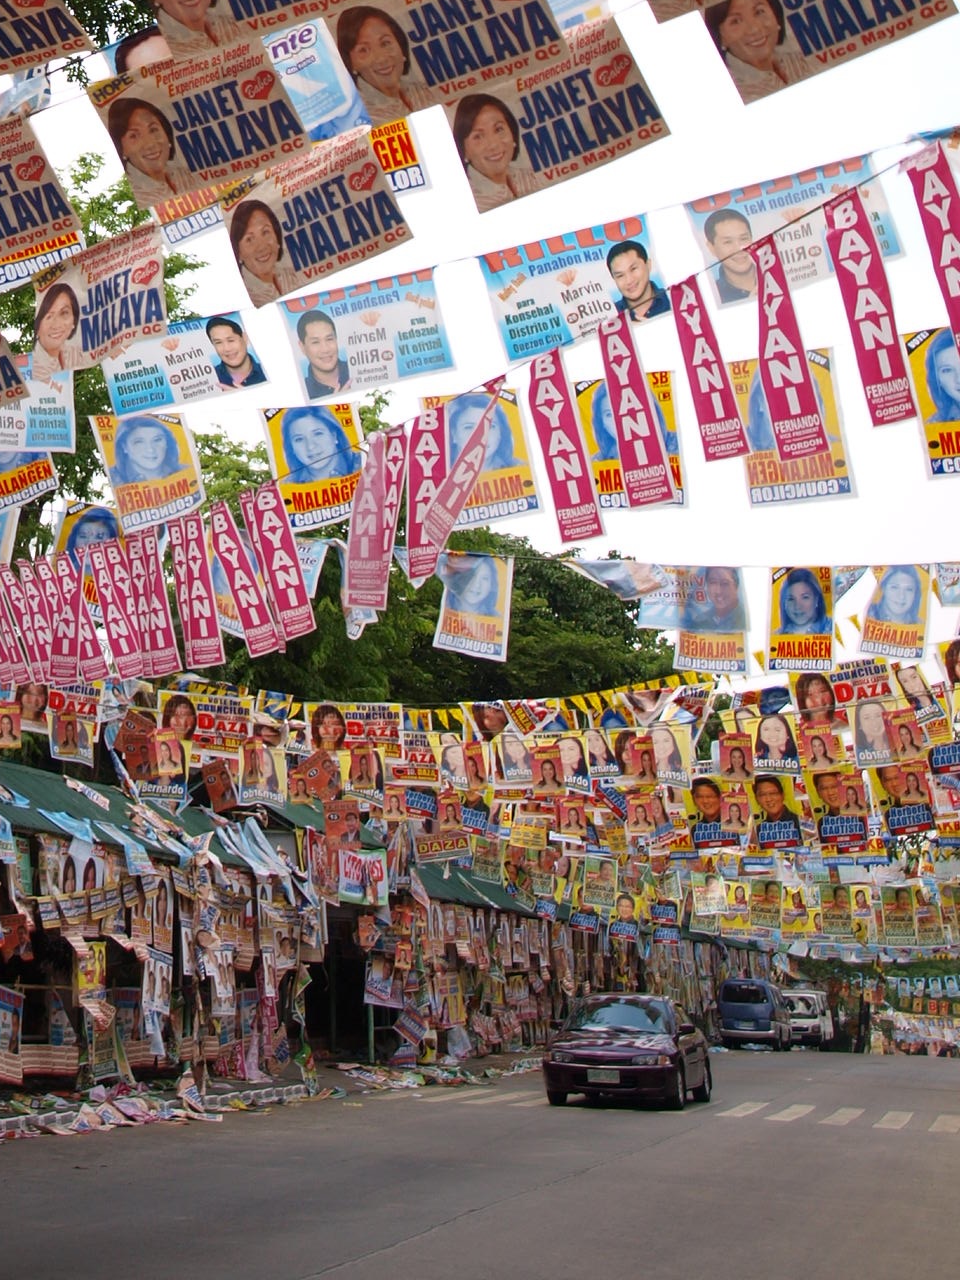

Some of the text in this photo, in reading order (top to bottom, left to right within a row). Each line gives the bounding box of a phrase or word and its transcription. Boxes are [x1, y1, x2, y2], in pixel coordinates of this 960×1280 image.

[172, 80, 244, 133] JANET
[516, 68, 598, 130] JANET
[177, 98, 304, 172] MALAYA
[520, 80, 666, 170] MALAYA
[281, 174, 348, 232] JANET
[285, 190, 405, 272] MALAYA
[528, 248, 605, 278] Panahon Na!
[560, 279, 604, 305] Marvin
[834, 200, 895, 378] BAYANI
[516, 297, 535, 310] para
[578, 298, 612, 321] Rillo
[504, 304, 555, 325] Konsehal
[508, 316, 561, 340] Distrito IV
[756, 245, 804, 415] BAYANI
[545, 333, 564, 345] City
[165, 346, 204, 367] Marvin
[179, 362, 213, 382] Rillo
[866, 377, 910, 399] FERNANDO
[875, 402, 913, 418] GORDON
[533, 354, 583, 505] BAYANI
[774, 413, 820, 435] FERNANDO
[782, 438, 823, 453] GORDON
[625, 464, 666, 483] FERNANDO
[557, 504, 596, 520] FERNANDO
[564, 523, 598, 537] GORDON
[187, 520, 211, 637] BAYANI
[213, 512, 260, 626] BAYANI
[776, 639, 831, 658] MALAÑGEN
[775, 659, 832, 670] COUNCILOR
[833, 683, 892, 703] DAZA
[195, 713, 248, 734] DAZA
[345, 721, 399, 739] DAZA
[754, 757, 798, 768] Bernardo
[142, 783, 184, 796] Bernardo
[417, 839, 469, 854] DAZA
